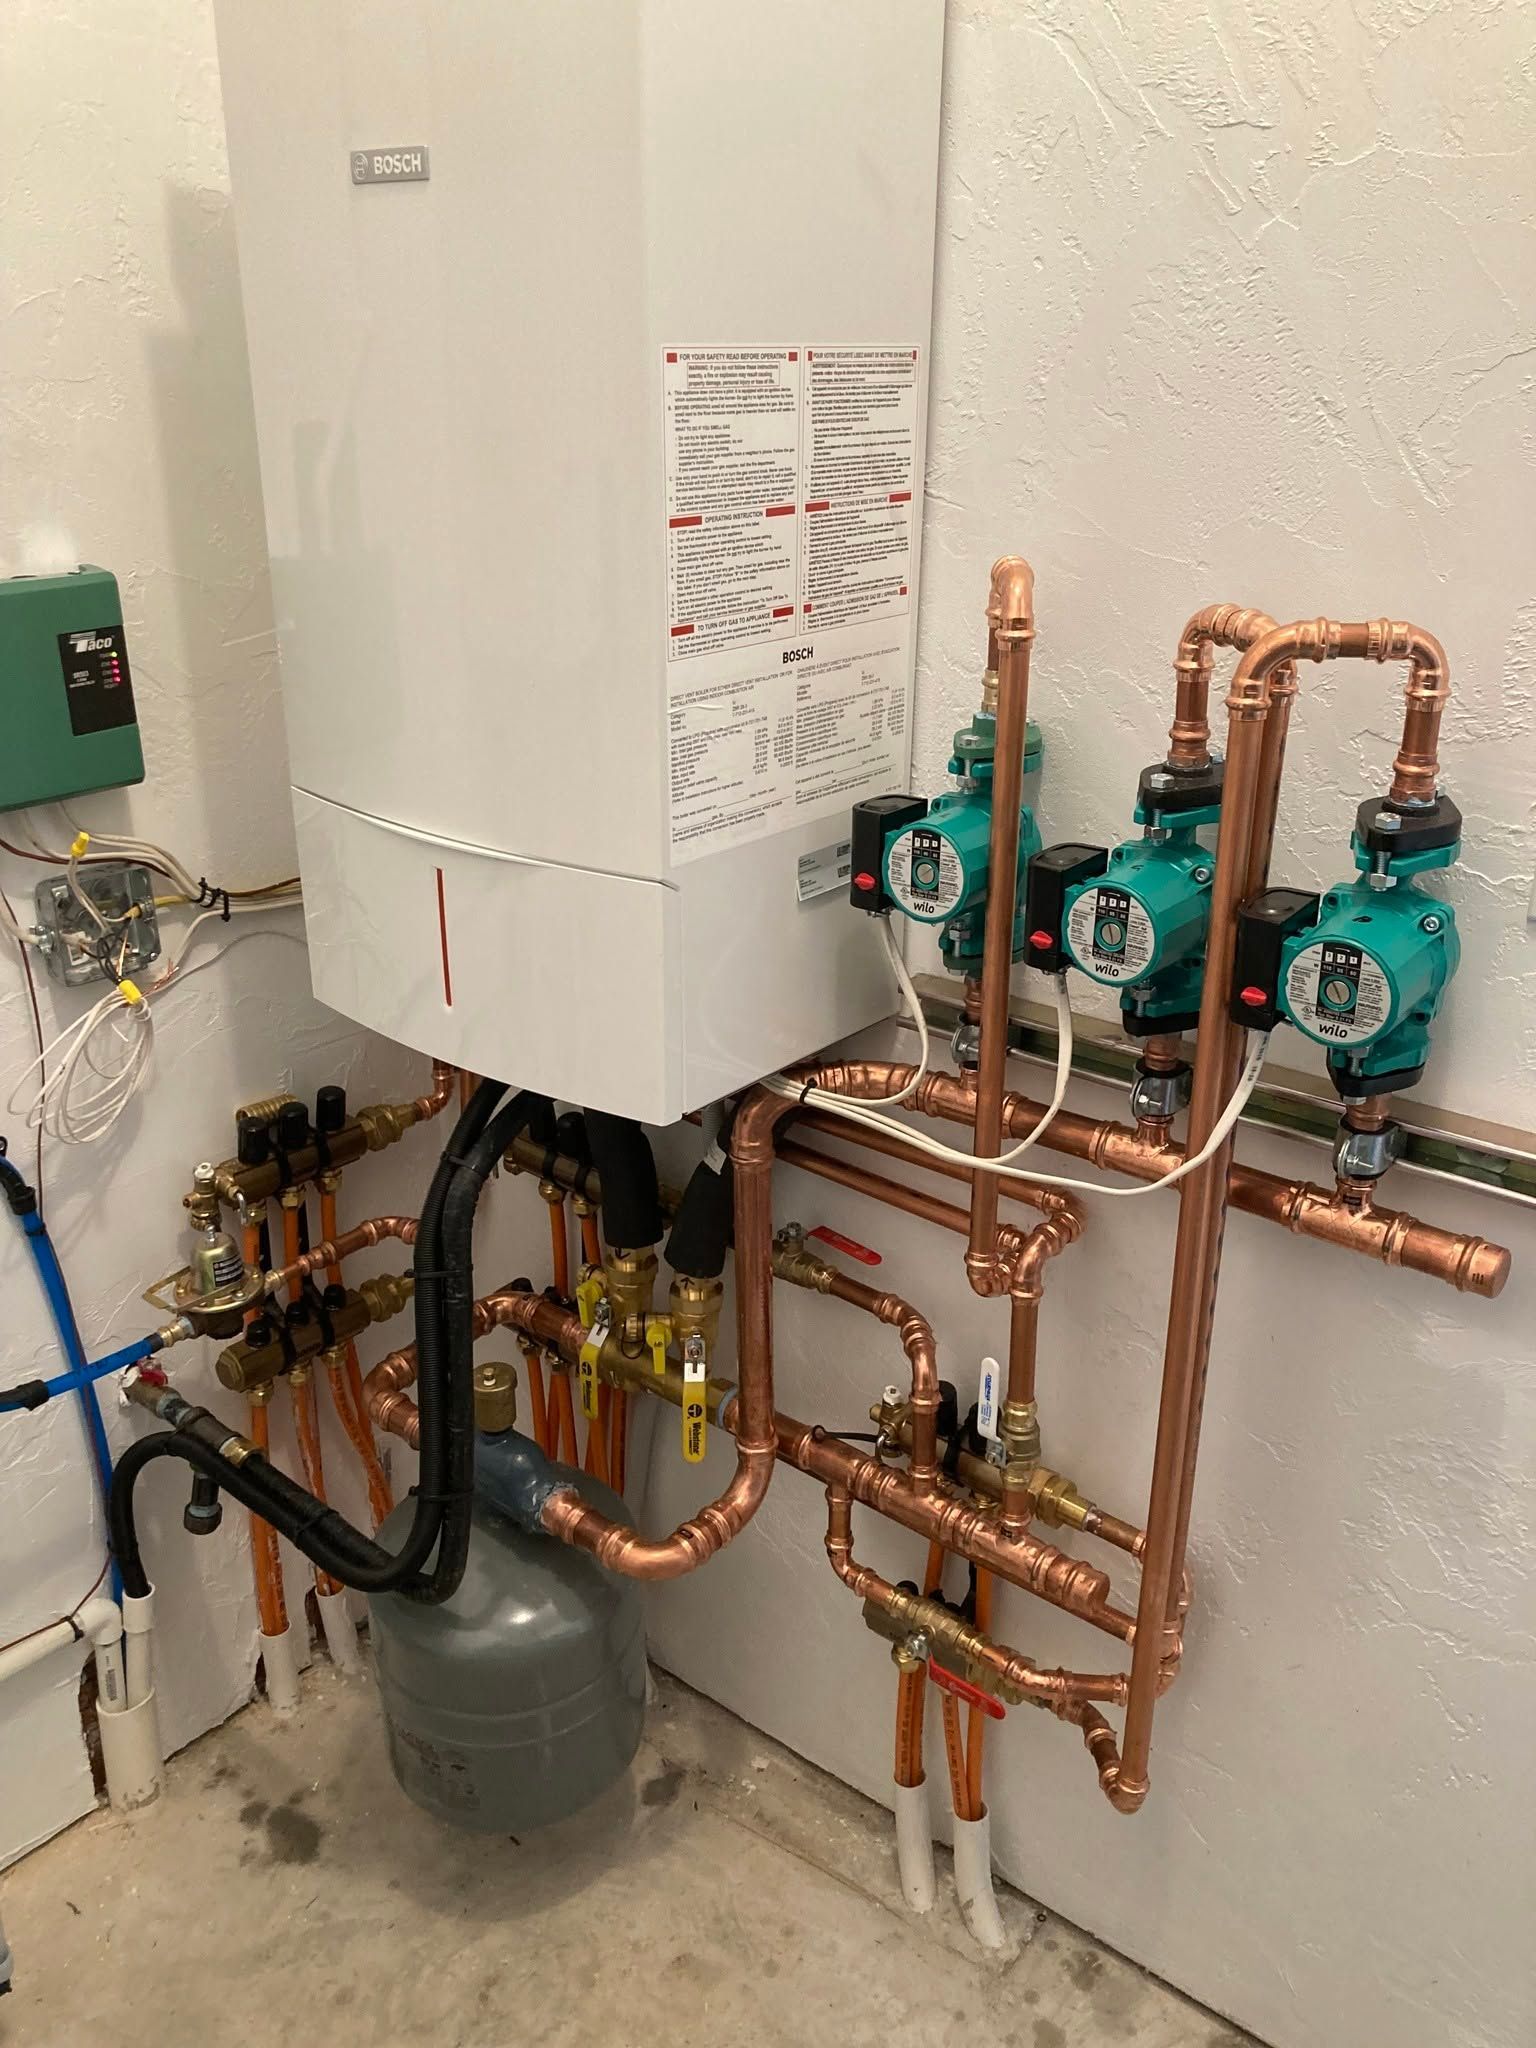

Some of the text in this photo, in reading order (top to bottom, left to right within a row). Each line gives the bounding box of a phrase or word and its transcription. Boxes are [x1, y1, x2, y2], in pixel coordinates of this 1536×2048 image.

[374, 153, 422, 174] BOSCH
[705, 511, 763, 523] OPERATING INSTRUCTION
[698, 612, 770, 632] TO TURN OFF GAS TO APPLIANCE
[69, 630, 112, 653] Taco
[782, 646, 814, 664] BOSCH
[914, 902, 934, 914] wilo
[1095, 963, 1119, 977] wilo
[1319, 1024, 1348, 1038] wilo
